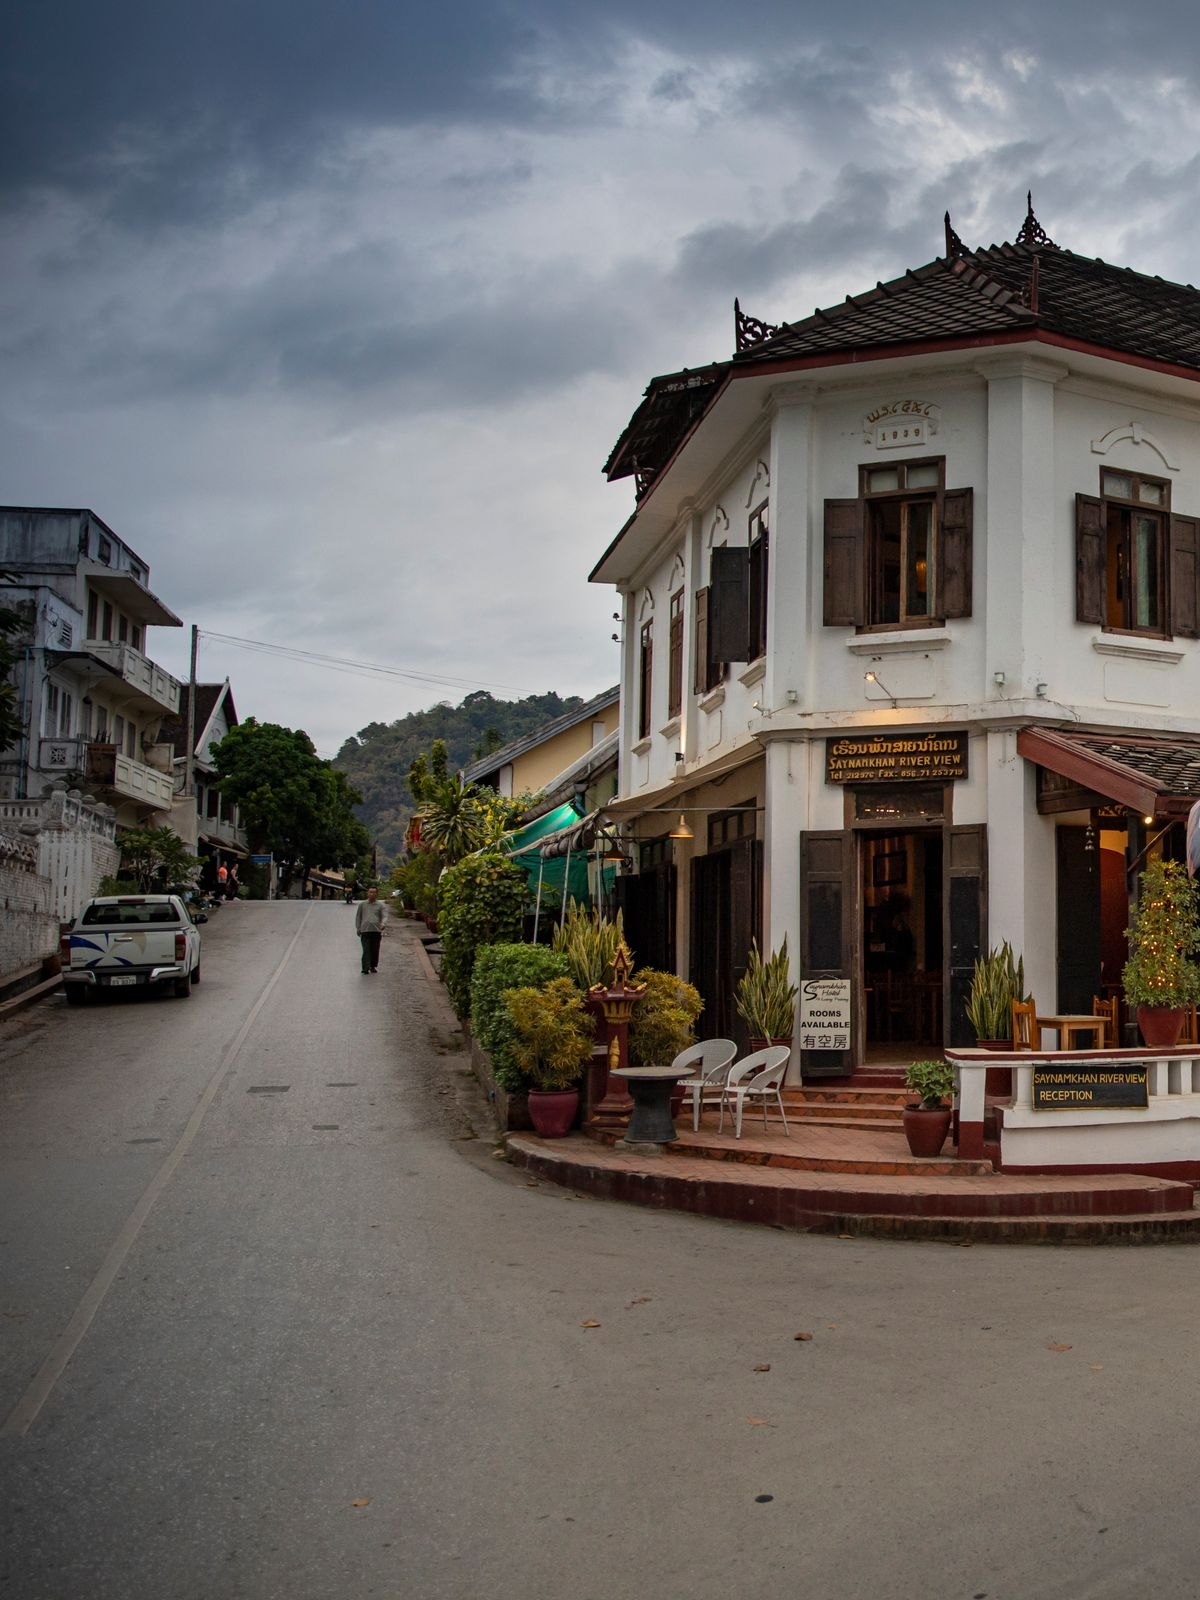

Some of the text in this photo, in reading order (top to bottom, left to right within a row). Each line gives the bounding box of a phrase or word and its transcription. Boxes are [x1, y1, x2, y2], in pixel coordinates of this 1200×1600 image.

[829, 754, 961, 770] SAYNAMKHAN RIVER VIEW
[878, 768, 898, 778] Fax:
[802, 1033, 848, 1048] 有空房
[1034, 1073, 1146, 1084] SAYNAMKHAN RIVER VIEW
[1040, 1090, 1093, 1101] RECEPTION
